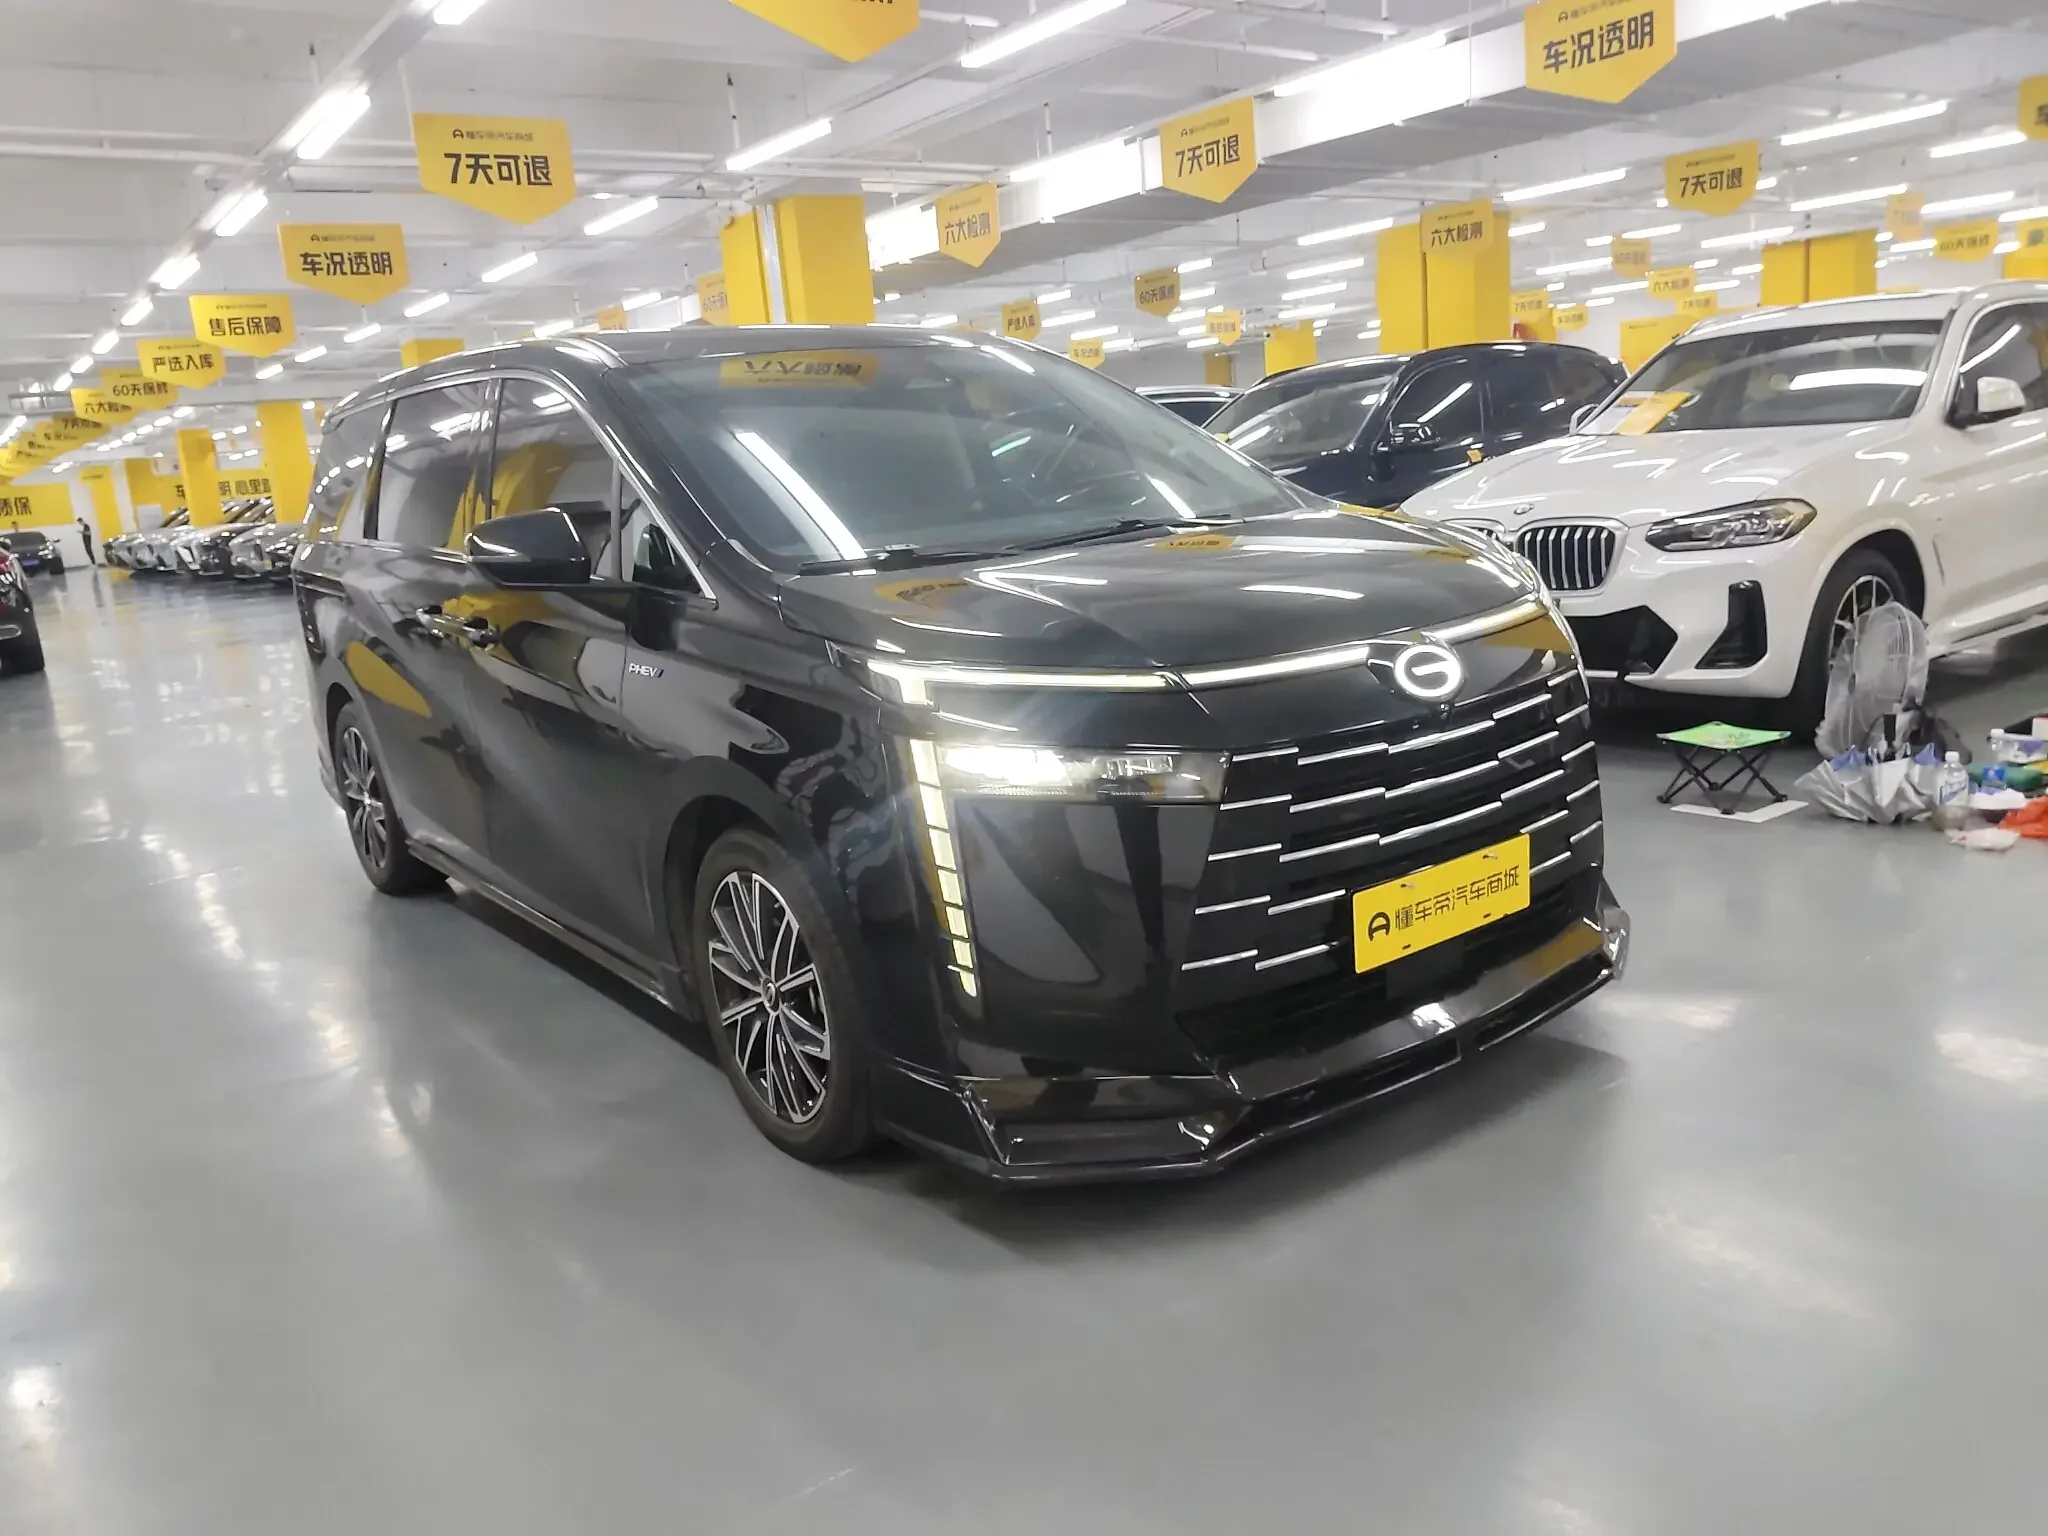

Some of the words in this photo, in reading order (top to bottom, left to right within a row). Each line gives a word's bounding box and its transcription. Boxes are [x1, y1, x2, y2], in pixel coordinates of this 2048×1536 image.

[1543, 10, 1654, 74] 车况透明
[444, 153, 553, 186] 7天可退
[1175, 134, 1241, 178] 7天可退
[1679, 167, 1743, 198] 7天可退
[944, 211, 991, 246] 六大检测
[1431, 221, 1483, 248] 六大检测
[300, 251, 393, 276] 车况透明
[209, 316, 282, 337] 售后保障
[152, 354, 216, 373] 严选入库
[629, 663, 658, 678] PHEV
[1394, 864, 1521, 931] 懂车帝汽车商城
